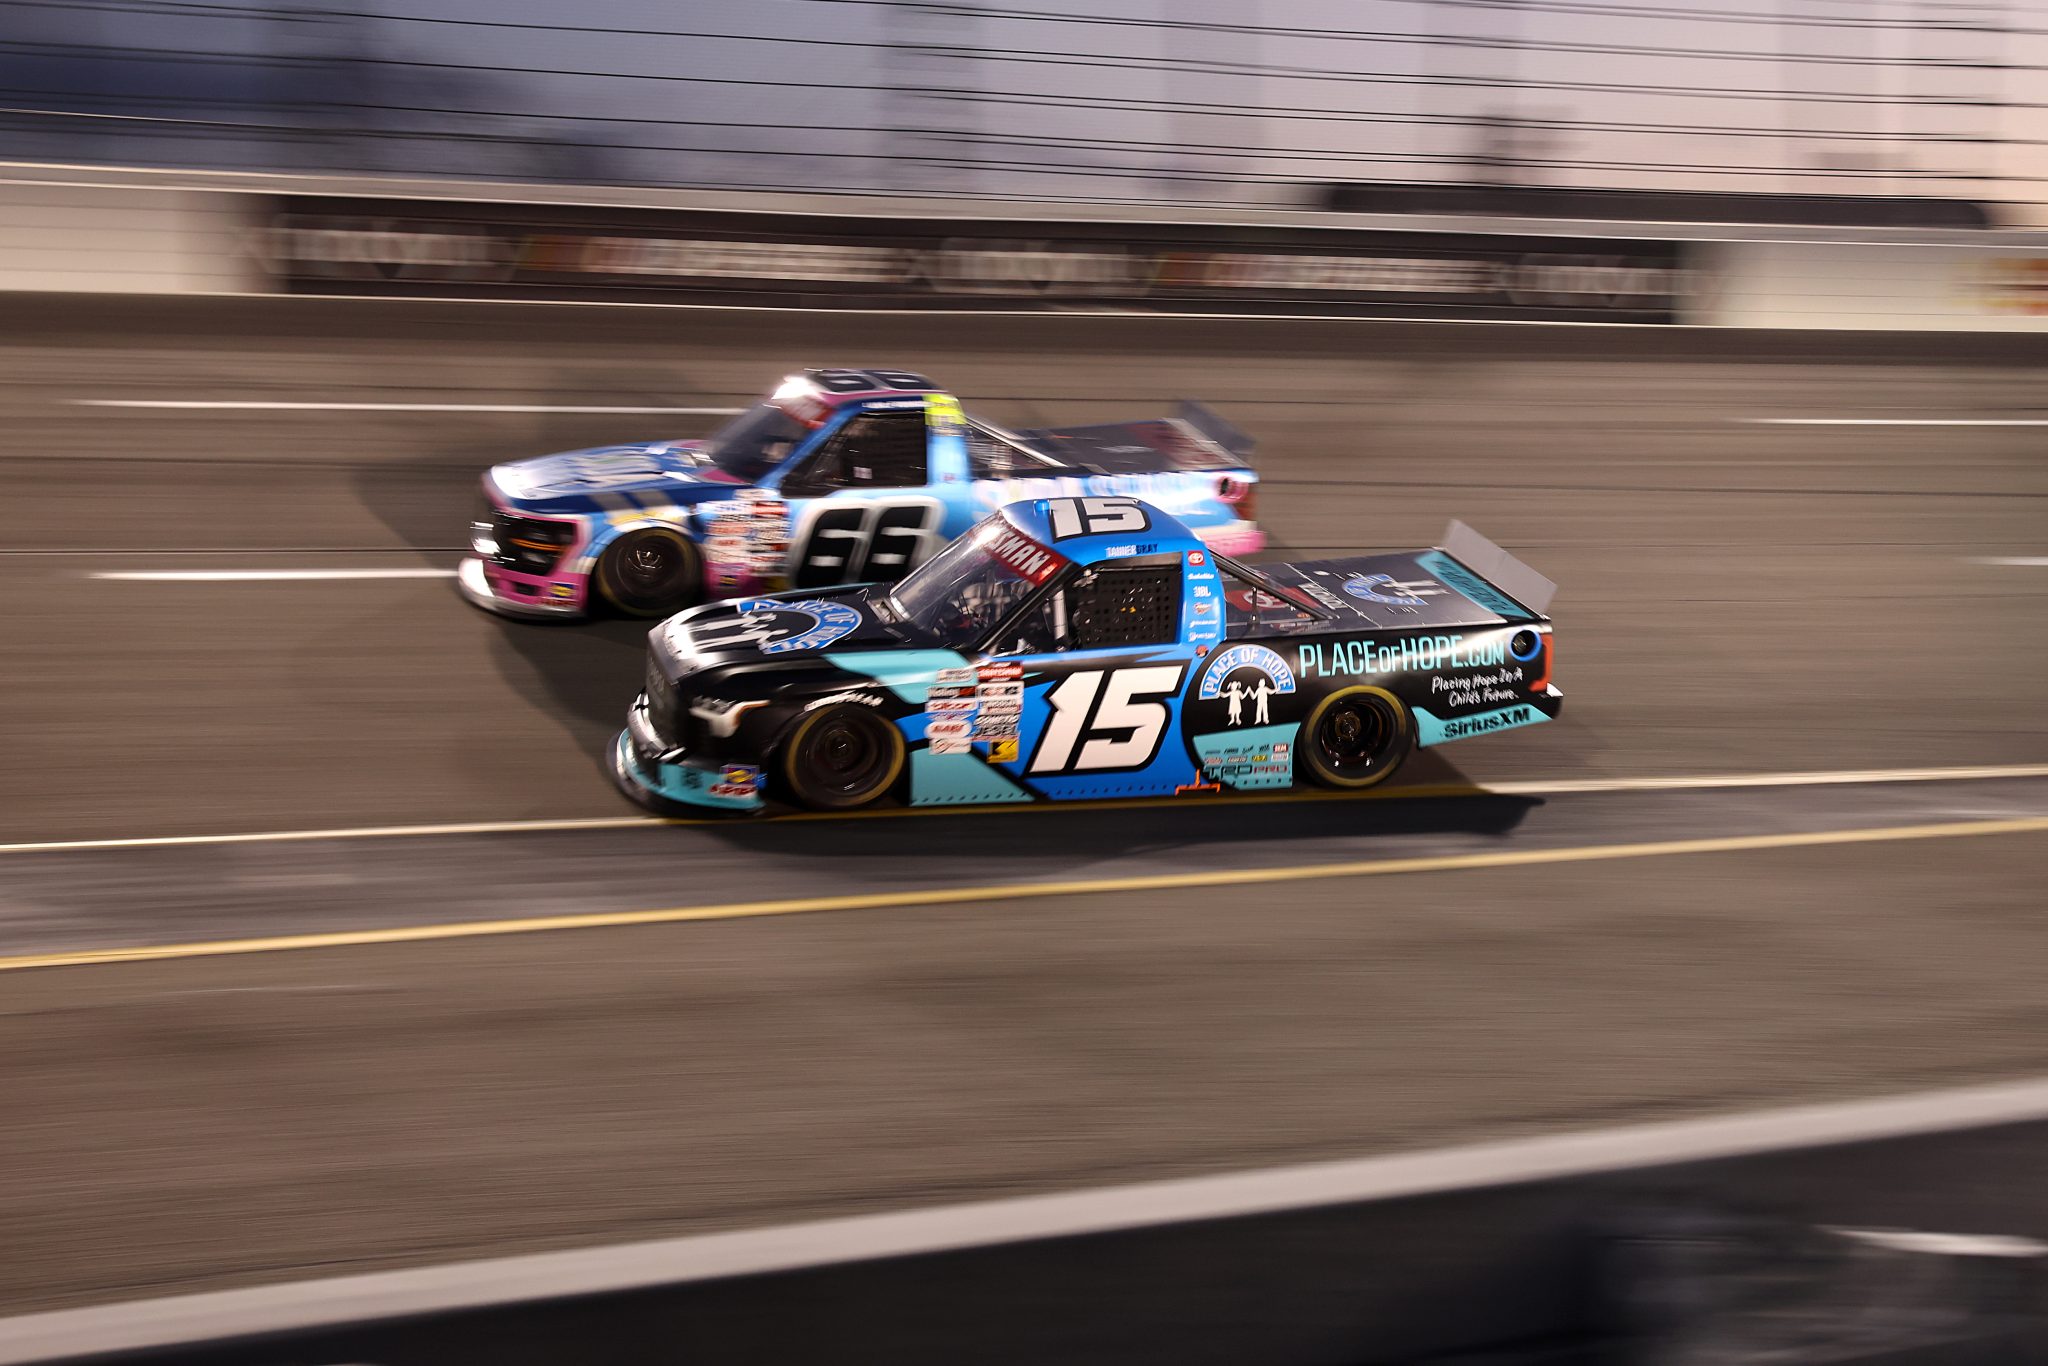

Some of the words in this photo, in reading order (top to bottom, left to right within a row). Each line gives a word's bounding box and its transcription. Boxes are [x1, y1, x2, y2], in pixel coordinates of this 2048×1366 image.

[1049, 497, 1149, 541] 15
[1204, 651, 1238, 693] PLACE
[1240, 648, 1259, 663] OF
[1261, 653, 1292, 689] HOPE
[1432, 675, 1470, 694] Placing
[1472, 673, 1498, 689] Hope
[1513, 666, 1523, 681] A
[1027, 664, 1184, 775] 15
[1444, 708, 1530, 738] SiriusXM
